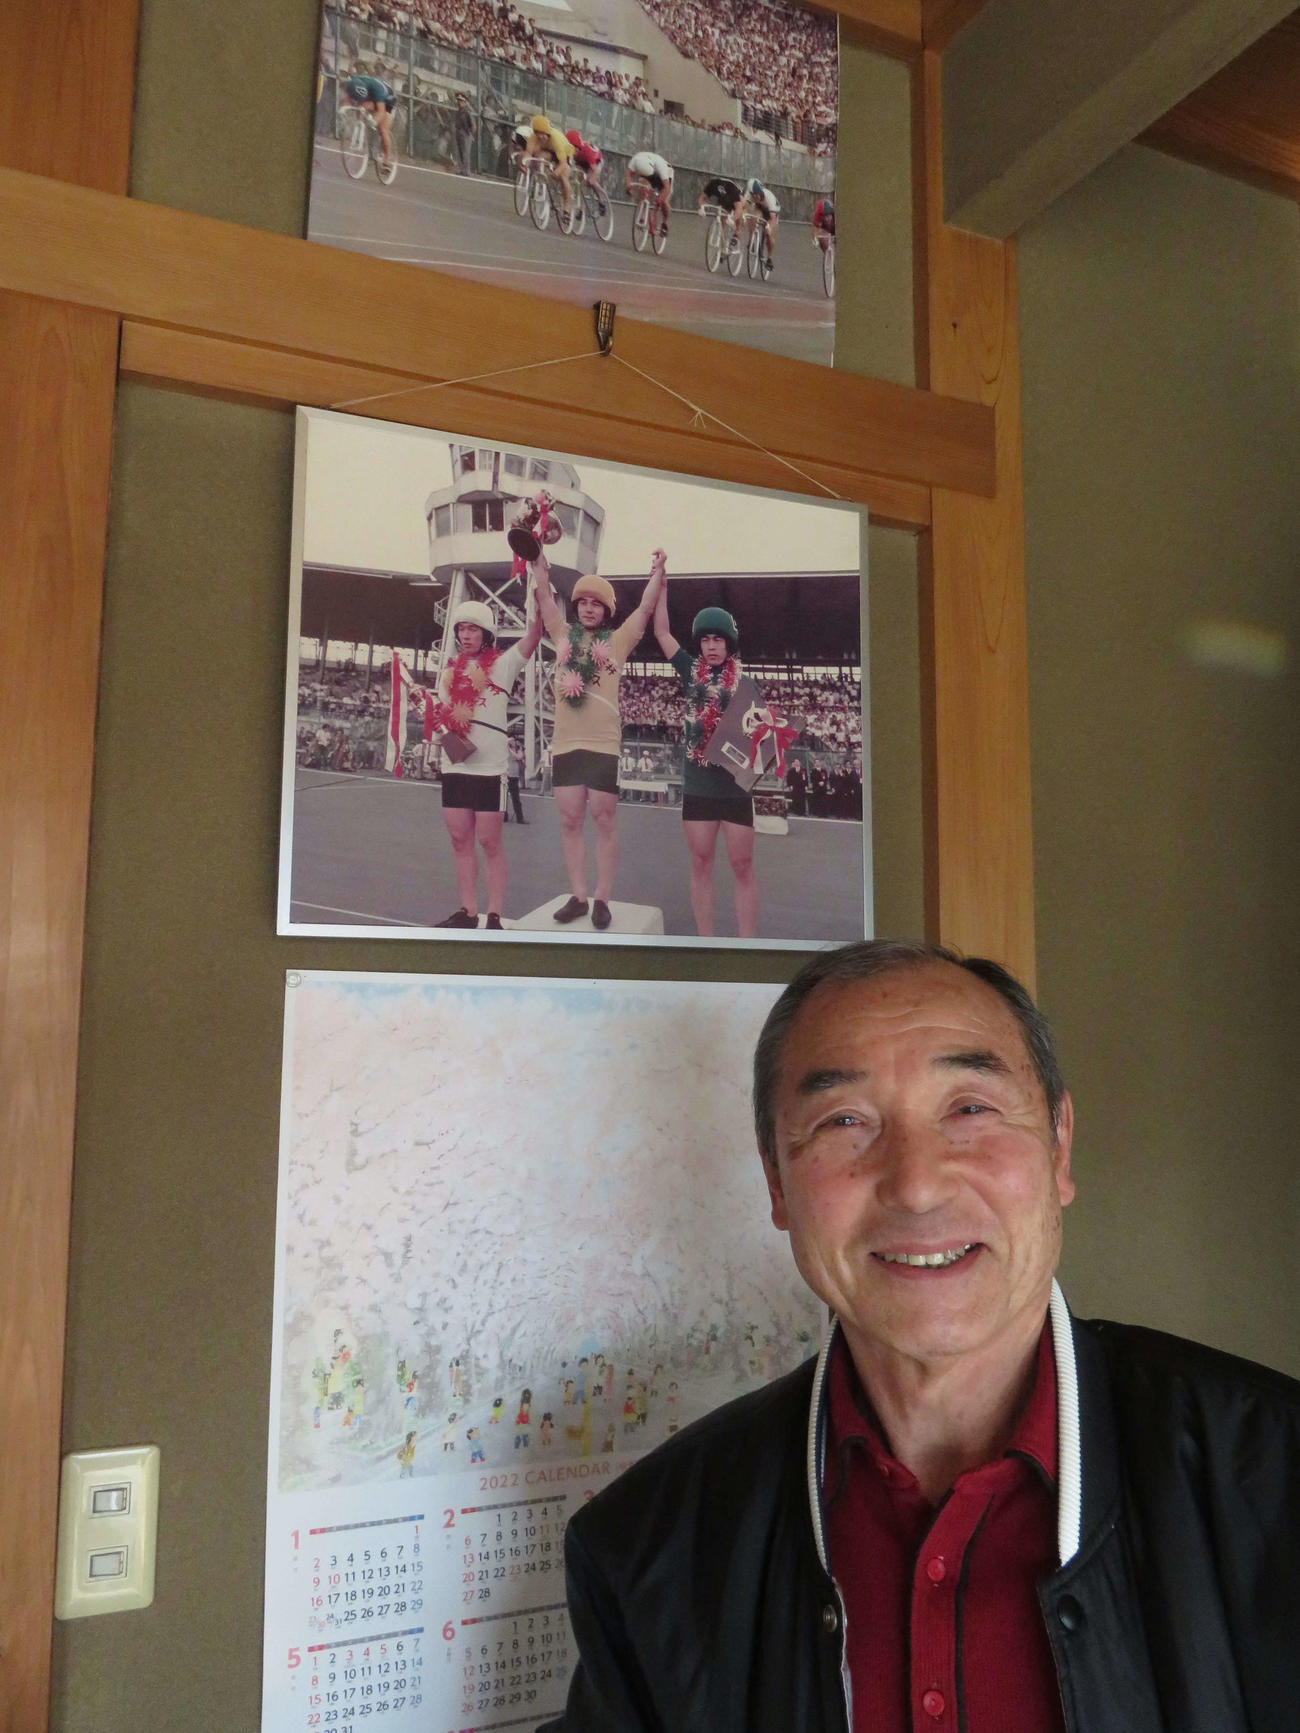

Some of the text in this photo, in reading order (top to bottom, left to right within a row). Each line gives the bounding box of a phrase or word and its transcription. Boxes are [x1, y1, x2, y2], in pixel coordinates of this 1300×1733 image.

[480, 1473, 520, 1490] 2022
[525, 1463, 610, 1484] CALENDAR
[443, 1509, 455, 1528] 2
[497, 1514, 500, 1522] 1
[512, 1512, 517, 1521] 2
[527, 1509, 533, 1519] 3
[542, 1507, 547, 1516] 4
[291, 1530, 299, 1549] 1
[415, 1525, 419, 1534] 1
[465, 1536, 471, 1545] 6
[481, 1534, 487, 1543] 7
[496, 1532, 502, 1541] 8
[511, 1529, 517, 1539] 9
[525, 1527, 535, 1537] 10
[540, 1525, 549, 1534] 11
[314, 1543, 419, 1568] 2 3 4 5 6 7 8
[463, 1554, 474, 1564] 13
[478, 1552, 489, 1561] 14
[494, 1550, 505, 1559] 15
[510, 1548, 520, 1557] 16
[525, 1545, 536, 1554] 17
[540, 1543, 550, 1552] 18
[313, 1562, 423, 1587] 9 10 11 12 13 14 15
[462, 1573, 474, 1583] 20
[478, 1570, 488, 1580] 21
[494, 1568, 505, 1578] 22
[510, 1565, 521, 1575] 23
[525, 1563, 536, 1573] 24
[539, 1561, 550, 1570] 25
[311, 1580, 423, 1607] 16 17 18 19 20 21 22
[463, 1588, 490, 1601] 27 28
[344, 1610, 356, 1621] 25
[361, 1607, 373, 1618] 26
[378, 1604, 390, 1615] 27
[394, 1602, 406, 1613] 28
[411, 1599, 423, 1610] 29
[442, 1621, 455, 1641] 6
[513, 1622, 517, 1630] 1
[528, 1618, 533, 1628] 2
[544, 1616, 549, 1625] 3
[313, 1638, 419, 1666] 1 2 3 4 5 6 7
[466, 1647, 471, 1657] 5
[481, 1645, 487, 1655] 6
[497, 1643, 503, 1652] 7
[513, 1639, 518, 1649] 8
[528, 1637, 534, 1646] 9
[542, 1634, 552, 1643] 10
[288, 1648, 301, 1668] 5
[464, 1666, 474, 1676] 12
[480, 1663, 490, 1673] 13
[495, 1660, 506, 1670] 14
[511, 1658, 521, 1667] 15
[526, 1655, 537, 1664] 16
[541, 1651, 552, 1661] 17
[312, 1657, 422, 1686] 8 9 10 11 12 13 14
[464, 1684, 475, 1694] 19
[479, 1682, 490, 1692] 20
[495, 1679, 504, 1688] 21
[510, 1676, 521, 1685] 22
[526, 1672, 536, 1682] 23
[541, 1670, 551, 1679] 24
[309, 1676, 420, 1705] 15 16 17 18 19 20 21
[462, 1690, 536, 1712] 26 27 28 29 30
[308, 1694, 422, 1725] 22 23 24 25 26 27 28
